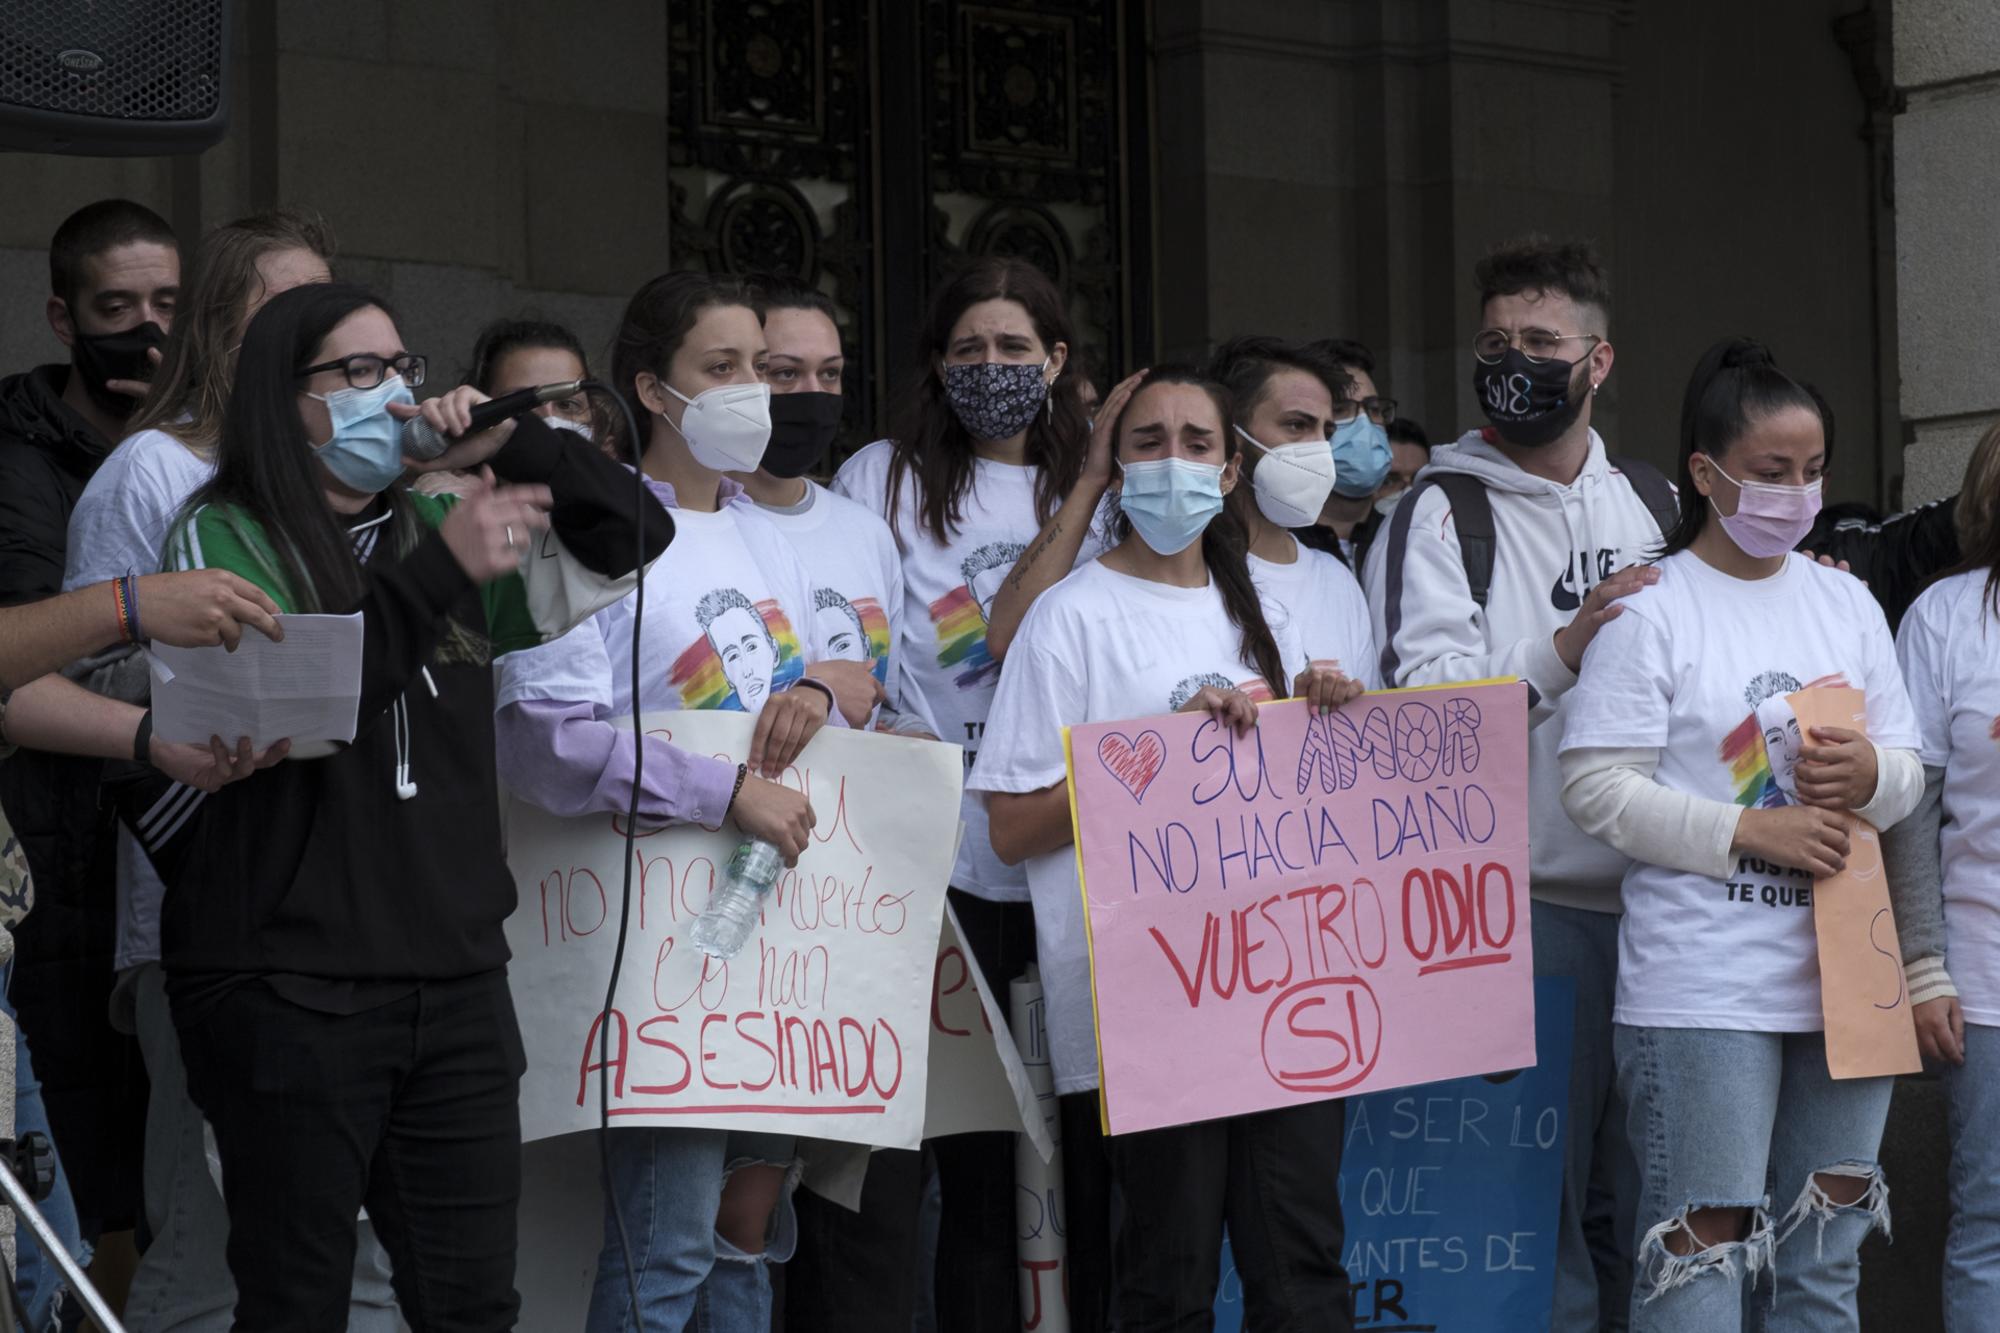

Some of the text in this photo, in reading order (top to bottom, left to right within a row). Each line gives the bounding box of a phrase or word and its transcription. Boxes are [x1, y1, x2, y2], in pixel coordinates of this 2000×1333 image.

[1192, 697, 1481, 805] SU AMOR
[1128, 784, 1497, 894] NO HACÍA DAÑO
[1725, 882, 1754, 903] TE
[757, 937, 830, 1012] han
[1148, 862, 1516, 1008] VUESTRO ODIO
[576, 1008, 903, 1107] ASESINADO
[1279, 990, 1364, 1079] SI
[1389, 1097, 1490, 1147] SER
[1509, 1104, 1559, 1150] LO
[1360, 1166, 1443, 1217] QUE
[1345, 1232, 1537, 1278] ANTES DE
